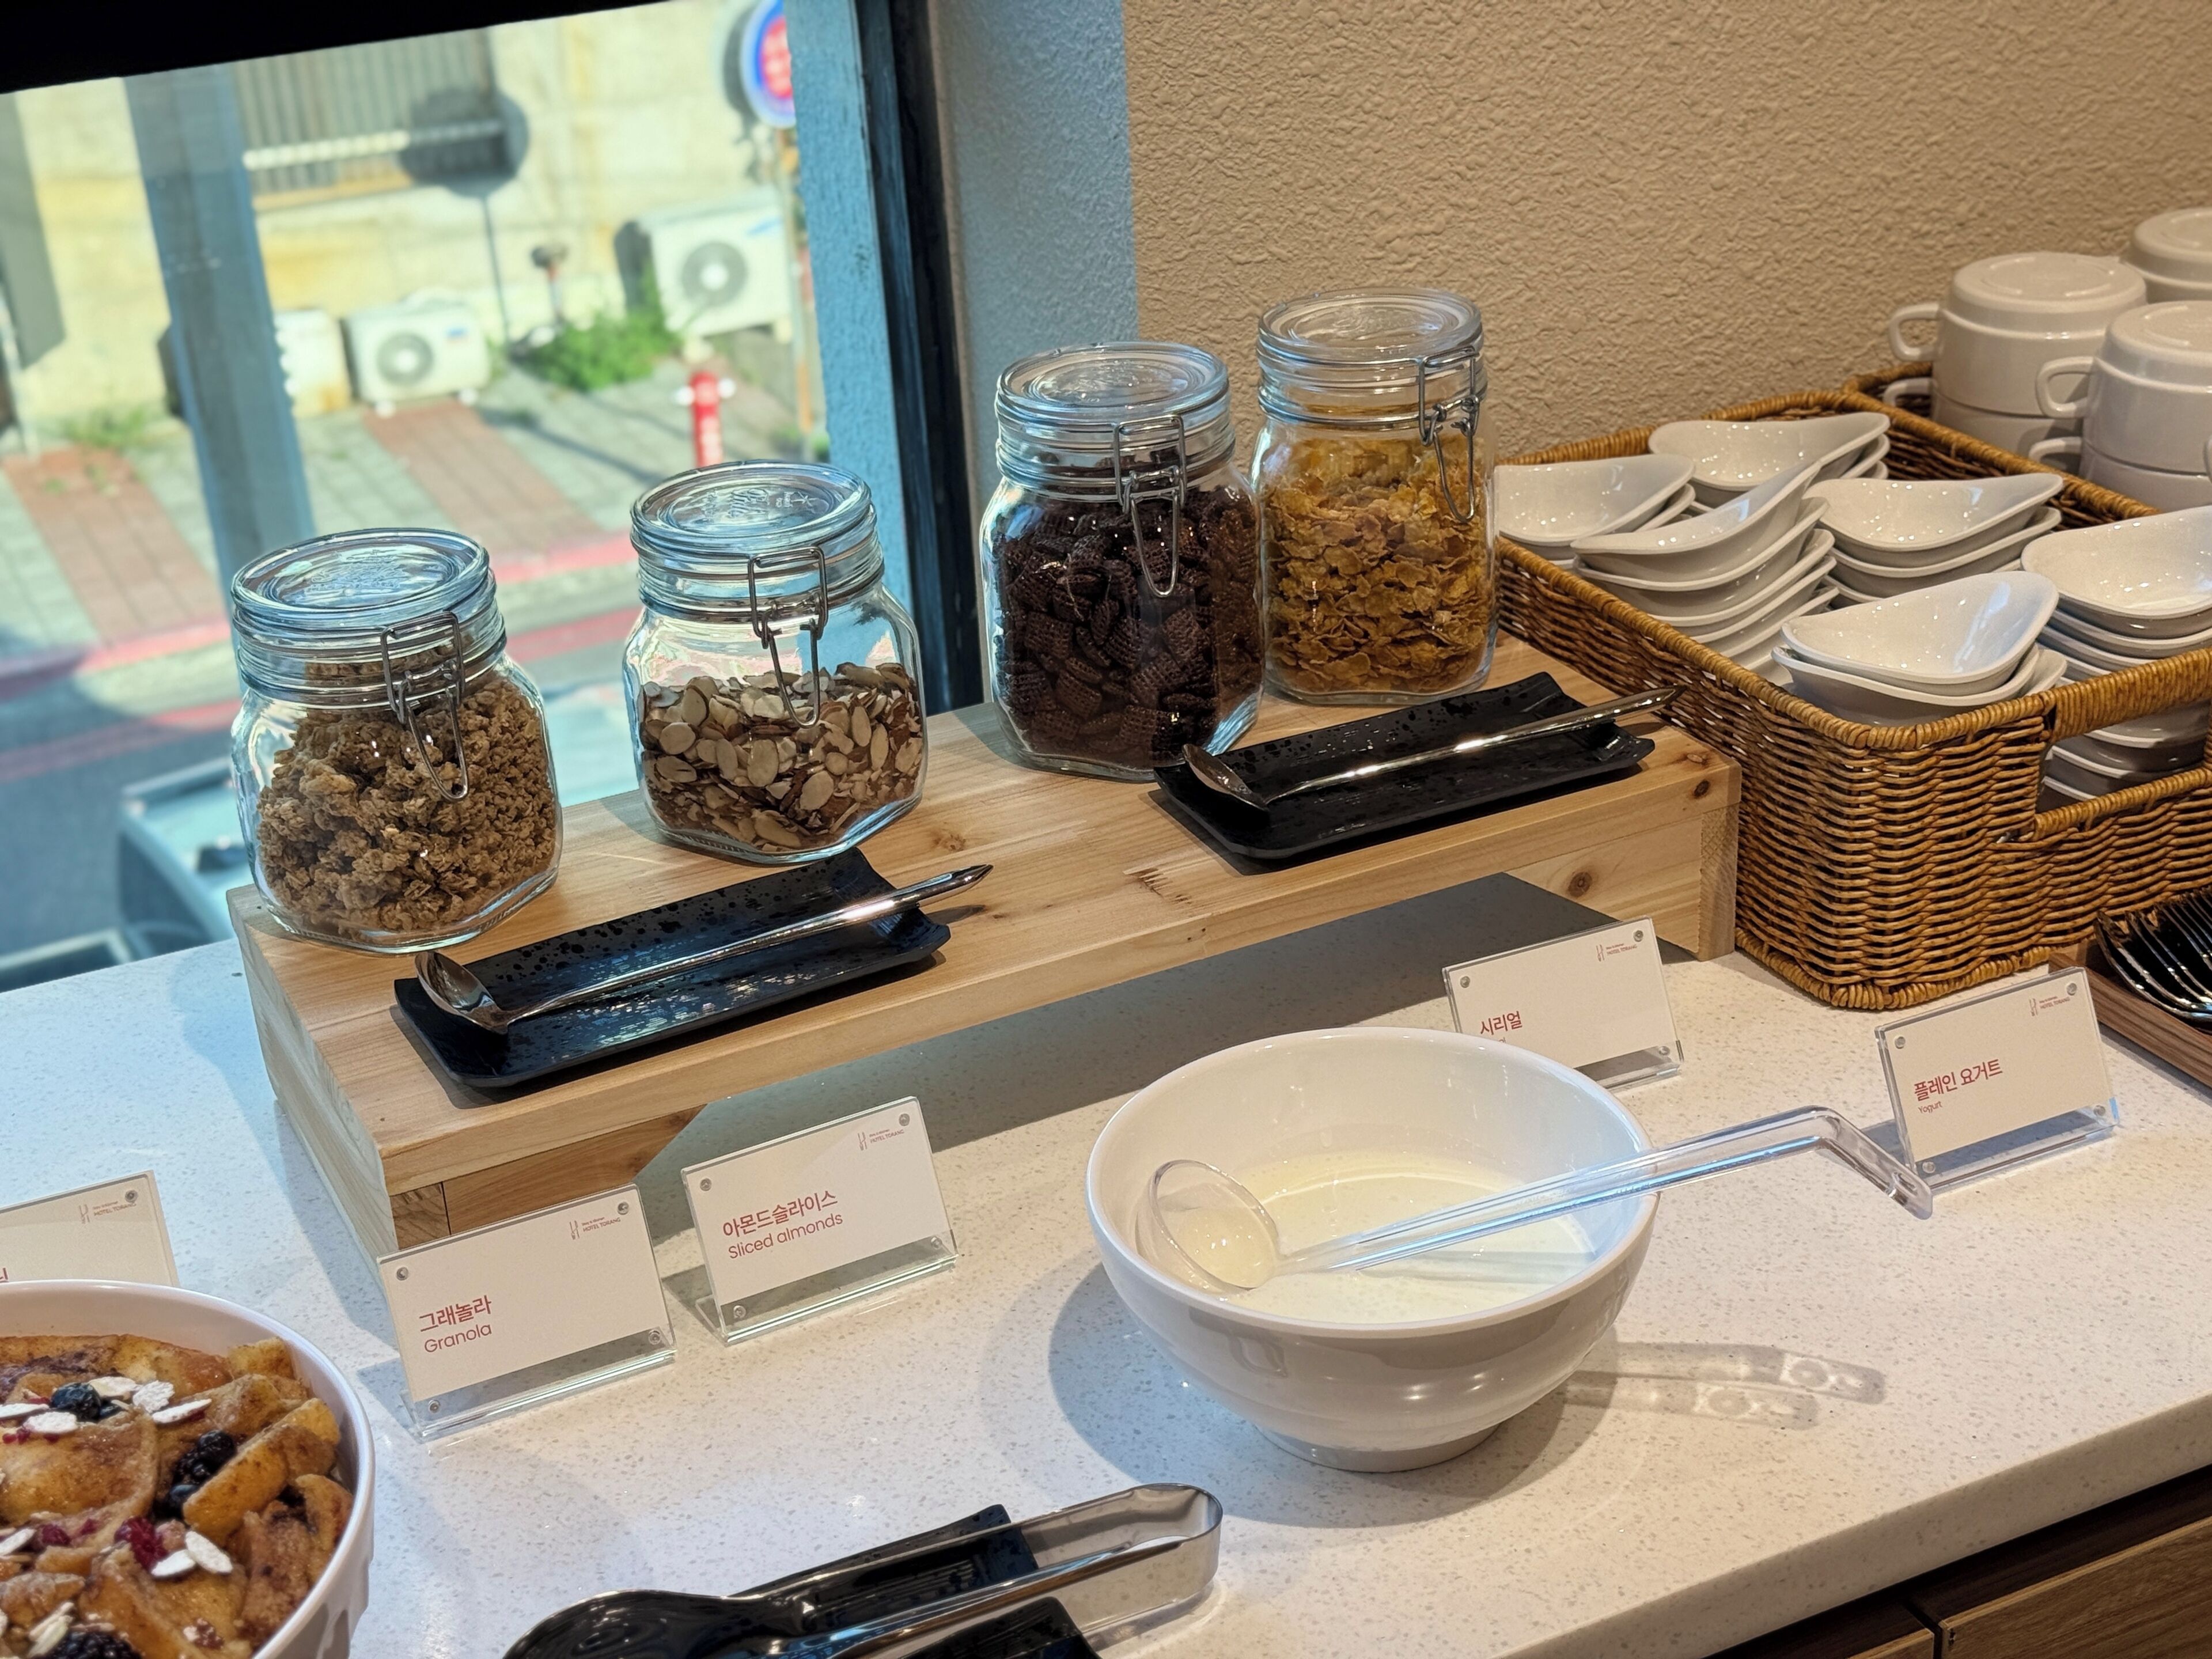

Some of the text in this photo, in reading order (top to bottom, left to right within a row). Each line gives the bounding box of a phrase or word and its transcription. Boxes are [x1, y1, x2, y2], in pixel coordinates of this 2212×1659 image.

[1480, 1010, 1523, 1036] 시리얼
[1914, 1059, 2003, 1101] 플레인 요거트
[1918, 1100, 1943, 1114] Yogurt
[722, 1190, 838, 1238] 아몬드슬라이스
[728, 1213, 843, 1259] Sliced almonds
[419, 1295, 492, 1333] 그래놀라
[424, 1323, 492, 1353] Granola
